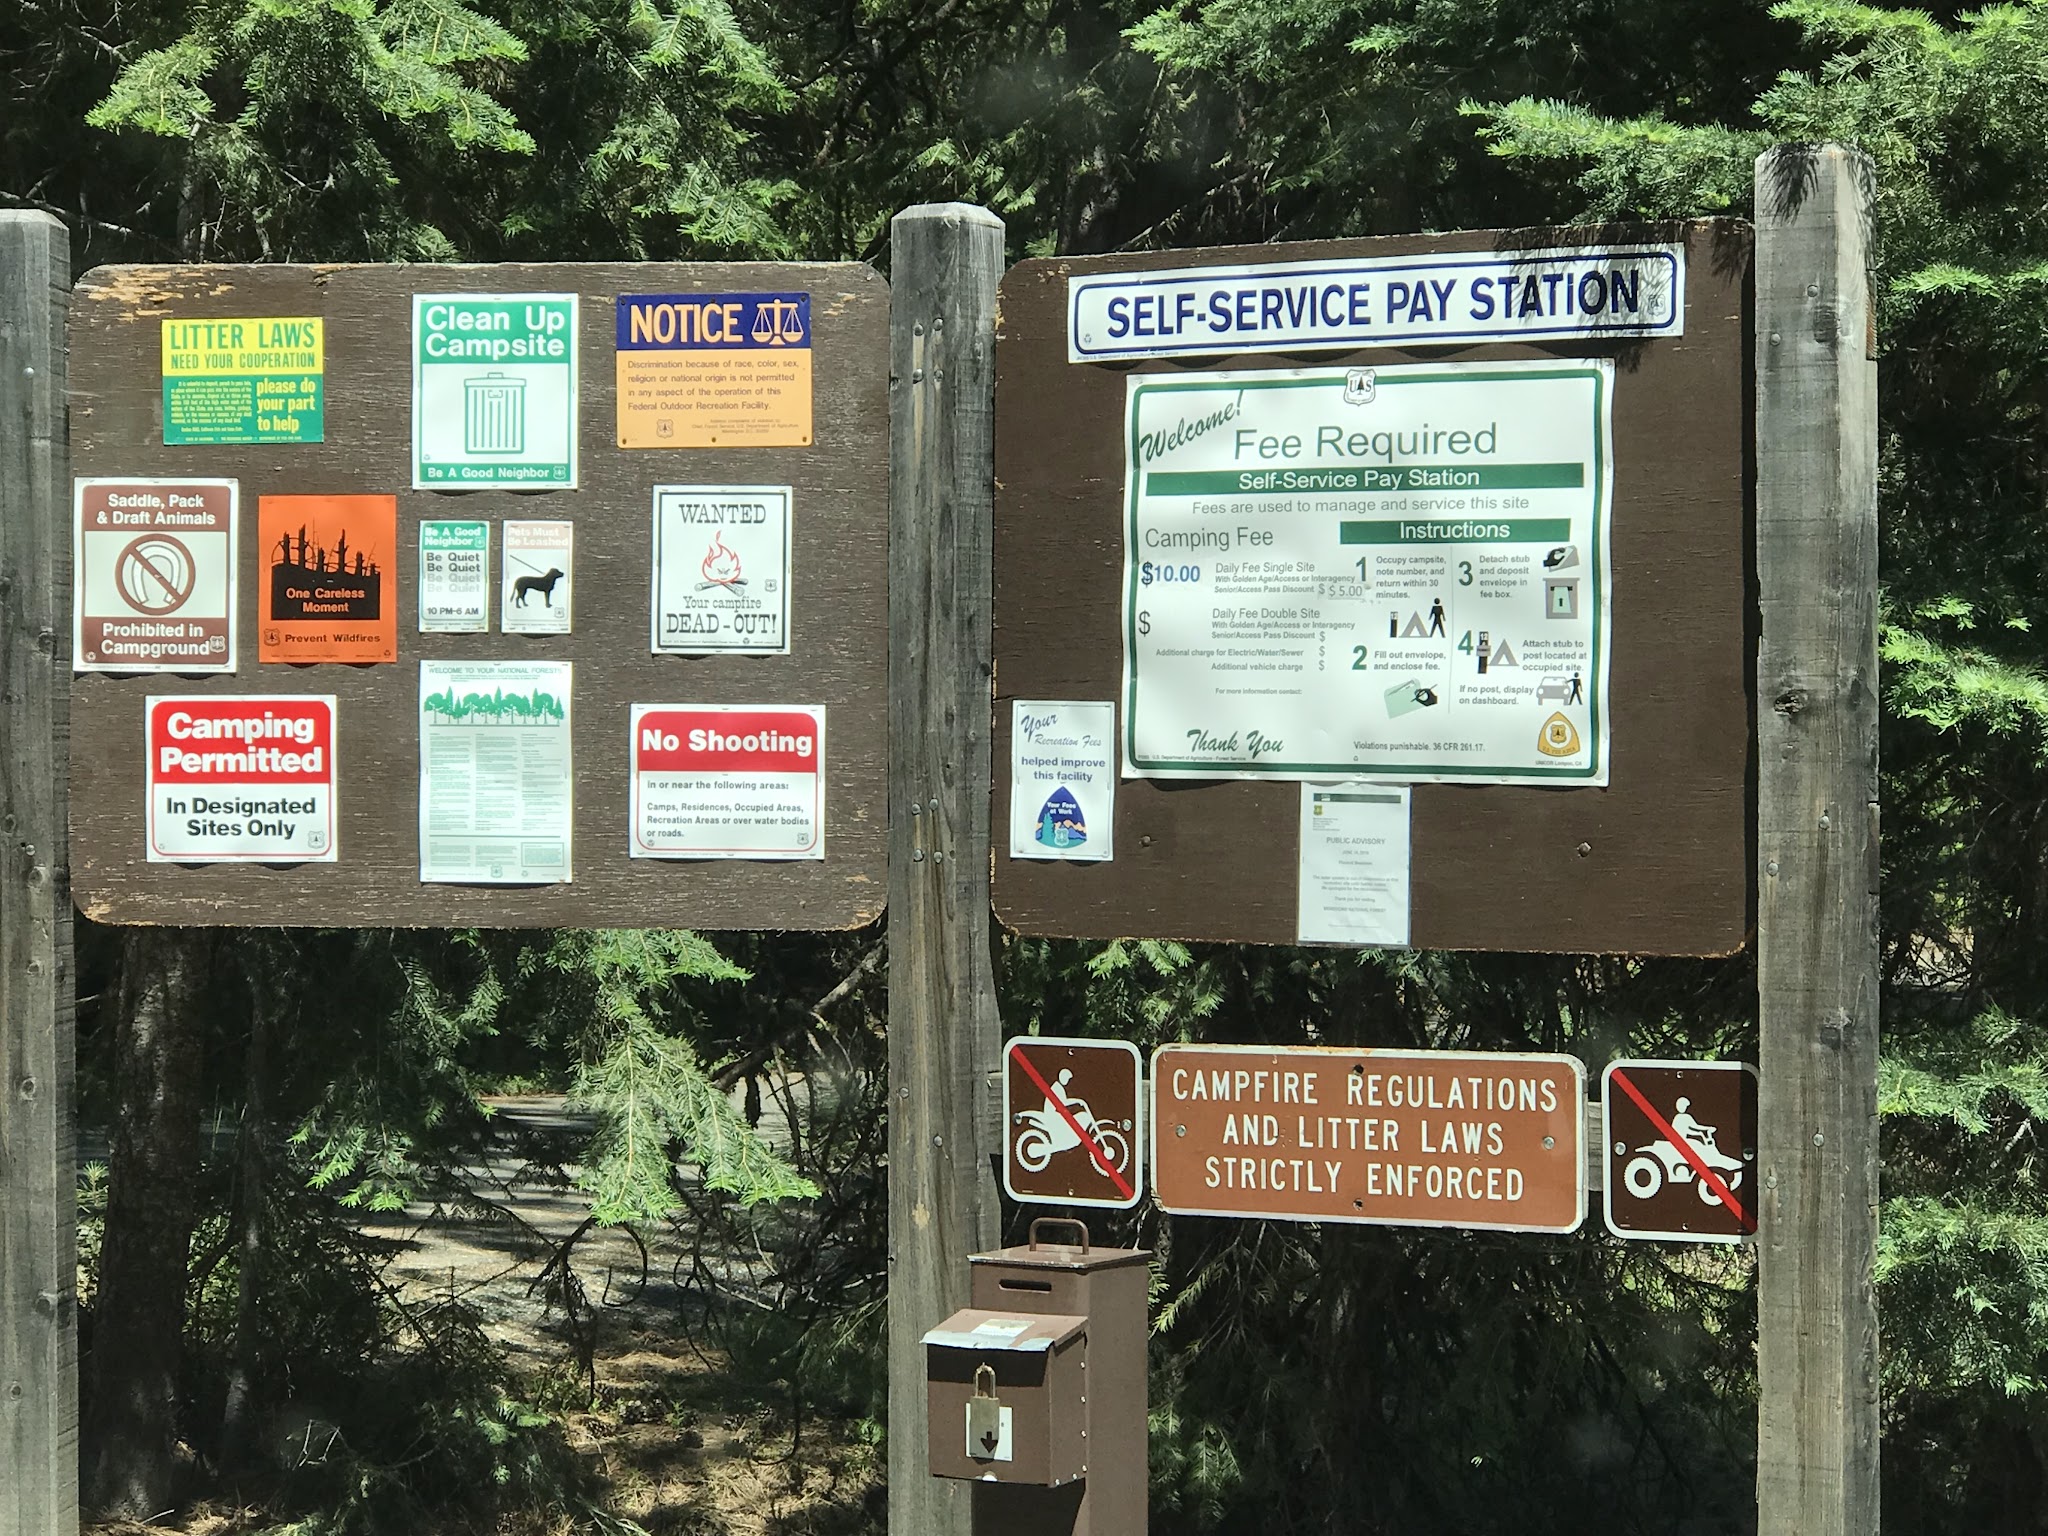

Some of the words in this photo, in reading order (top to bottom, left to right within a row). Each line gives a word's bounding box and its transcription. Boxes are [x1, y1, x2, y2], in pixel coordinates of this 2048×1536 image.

[1108, 284, 1370, 338] SELF-SERVICE
[1387, 280, 1456, 322] PAY
[1470, 269, 1638, 320] STATION
[426, 306, 510, 330] Clean
[526, 306, 565, 334] Up
[631, 304, 743, 343] NOTICE
[171, 324, 243, 350] LITTER
[259, 323, 314, 348] LAWS
[425, 333, 565, 360] Campsite
[171, 354, 198, 369] NEED
[204, 354, 233, 369] YOUR
[240, 353, 315, 368] COOPERATION
[723, 360, 731, 368] of
[257, 378, 296, 396] please
[300, 377, 316, 393] do
[628, 375, 656, 384] religion
[705, 374, 727, 383] origin
[756, 374, 794, 382] permitted
[257, 396, 285, 414] your
[288, 395, 315, 413] part
[628, 402, 657, 411] Federal
[660, 402, 693, 410] Outdoor
[696, 402, 738, 410] Recreation
[257, 416, 270, 431] to
[273, 415, 299, 434] help
[1139, 389, 1244, 462] Welcome!
[1235, 429, 1301, 460] Fee
[1317, 422, 1496, 463] Required
[427, 467, 443, 478] Be
[448, 467, 457, 478] A
[462, 467, 493, 478] Good
[498, 468, 549, 480] Neighbor
[1239, 472, 1358, 489] Self-Service
[1365, 471, 1403, 490] Pay
[1409, 470, 1479, 486] Station
[108, 494, 165, 509] Saddle,
[169, 494, 204, 508] Pack
[1193, 502, 1226, 513] Fees
[1231, 504, 1253, 512] are
[1258, 501, 1292, 512] used
[1298, 501, 1310, 511] to
[1315, 500, 1375, 514] manage
[1381, 498, 1407, 510] and
[1412, 497, 1465, 510] service
[1471, 497, 1497, 509] this
[1502, 497, 1529, 508] site
[97, 511, 108, 524] &
[113, 511, 150, 524] Draft
[154, 512, 215, 525] Animals
[679, 504, 765, 524] WANTED
[424, 528, 438, 536] Be
[442, 528, 450, 536] A
[454, 528, 481, 536] Good
[508, 528, 530, 536] Pets
[533, 528, 559, 536] Must
[1146, 528, 1229, 552] Camping
[1237, 527, 1273, 546] Fee
[1399, 521, 1510, 540] Instructions
[424, 537, 473, 546] Neighbor
[508, 537, 522, 546] Be
[524, 537, 568, 546] Leashed
[427, 552, 442, 562] Be
[448, 552, 480, 562] Quiet
[1376, 556, 1407, 565] Occupy
[427, 563, 443, 572] Be
[449, 563, 480, 572] Quiet
[1141, 561, 1200, 588] $10.00
[1216, 562, 1240, 575] Daily
[1242, 562, 1260, 573] Fee
[1264, 562, 1293, 575] Single
[1296, 562, 1315, 572] Site
[1356, 557, 1366, 582] 1
[1459, 561, 1473, 586] 3
[286, 588, 310, 599] One
[315, 588, 365, 598] Careless
[303, 602, 349, 612] Moment
[683, 596, 709, 609] Your
[713, 596, 761, 613] campfire
[103, 623, 184, 637] Prohibited
[189, 624, 203, 637] in
[285, 634, 327, 643] Prevent
[333, 634, 380, 642] Wildfires
[101, 640, 210, 658] Campground
[1458, 630, 1474, 655] 4
[1352, 645, 1367, 670] 2
[168, 712, 314, 744] Camping
[1021, 713, 1058, 742] Your
[642, 729, 679, 751] No
[688, 729, 812, 757] Shooting
[1034, 734, 1078, 746] Recreation
[1082, 735, 1102, 748] Fees
[1187, 729, 1239, 752] Thank
[1246, 730, 1284, 759] You
[161, 747, 322, 773] Permitted
[1022, 757, 1058, 767] helped
[1061, 758, 1105, 768] improve
[696, 781, 711, 789] the
[714, 781, 756, 791] following
[1034, 771, 1054, 780] this
[1057, 771, 1092, 783] facility
[167, 798, 186, 814] In
[193, 798, 315, 817] Designated
[734, 803, 774, 813] Occupied
[187, 819, 242, 836] Sites
[248, 820, 295, 840] Only
[647, 816, 692, 824] Recreation
[695, 816, 719, 824] Areas
[781, 817, 809, 825] bodies
[1173, 1069, 1318, 1104] CAMPFIRE
[1348, 1074, 1557, 1112] REGULATIONS
[1223, 1114, 1279, 1146] AND
[1299, 1117, 1398, 1151] LITTER
[1421, 1120, 1503, 1155] LAWS
[1205, 1157, 1341, 1192] STRICTLY
[1367, 1164, 1524, 1200] ENFORCED
